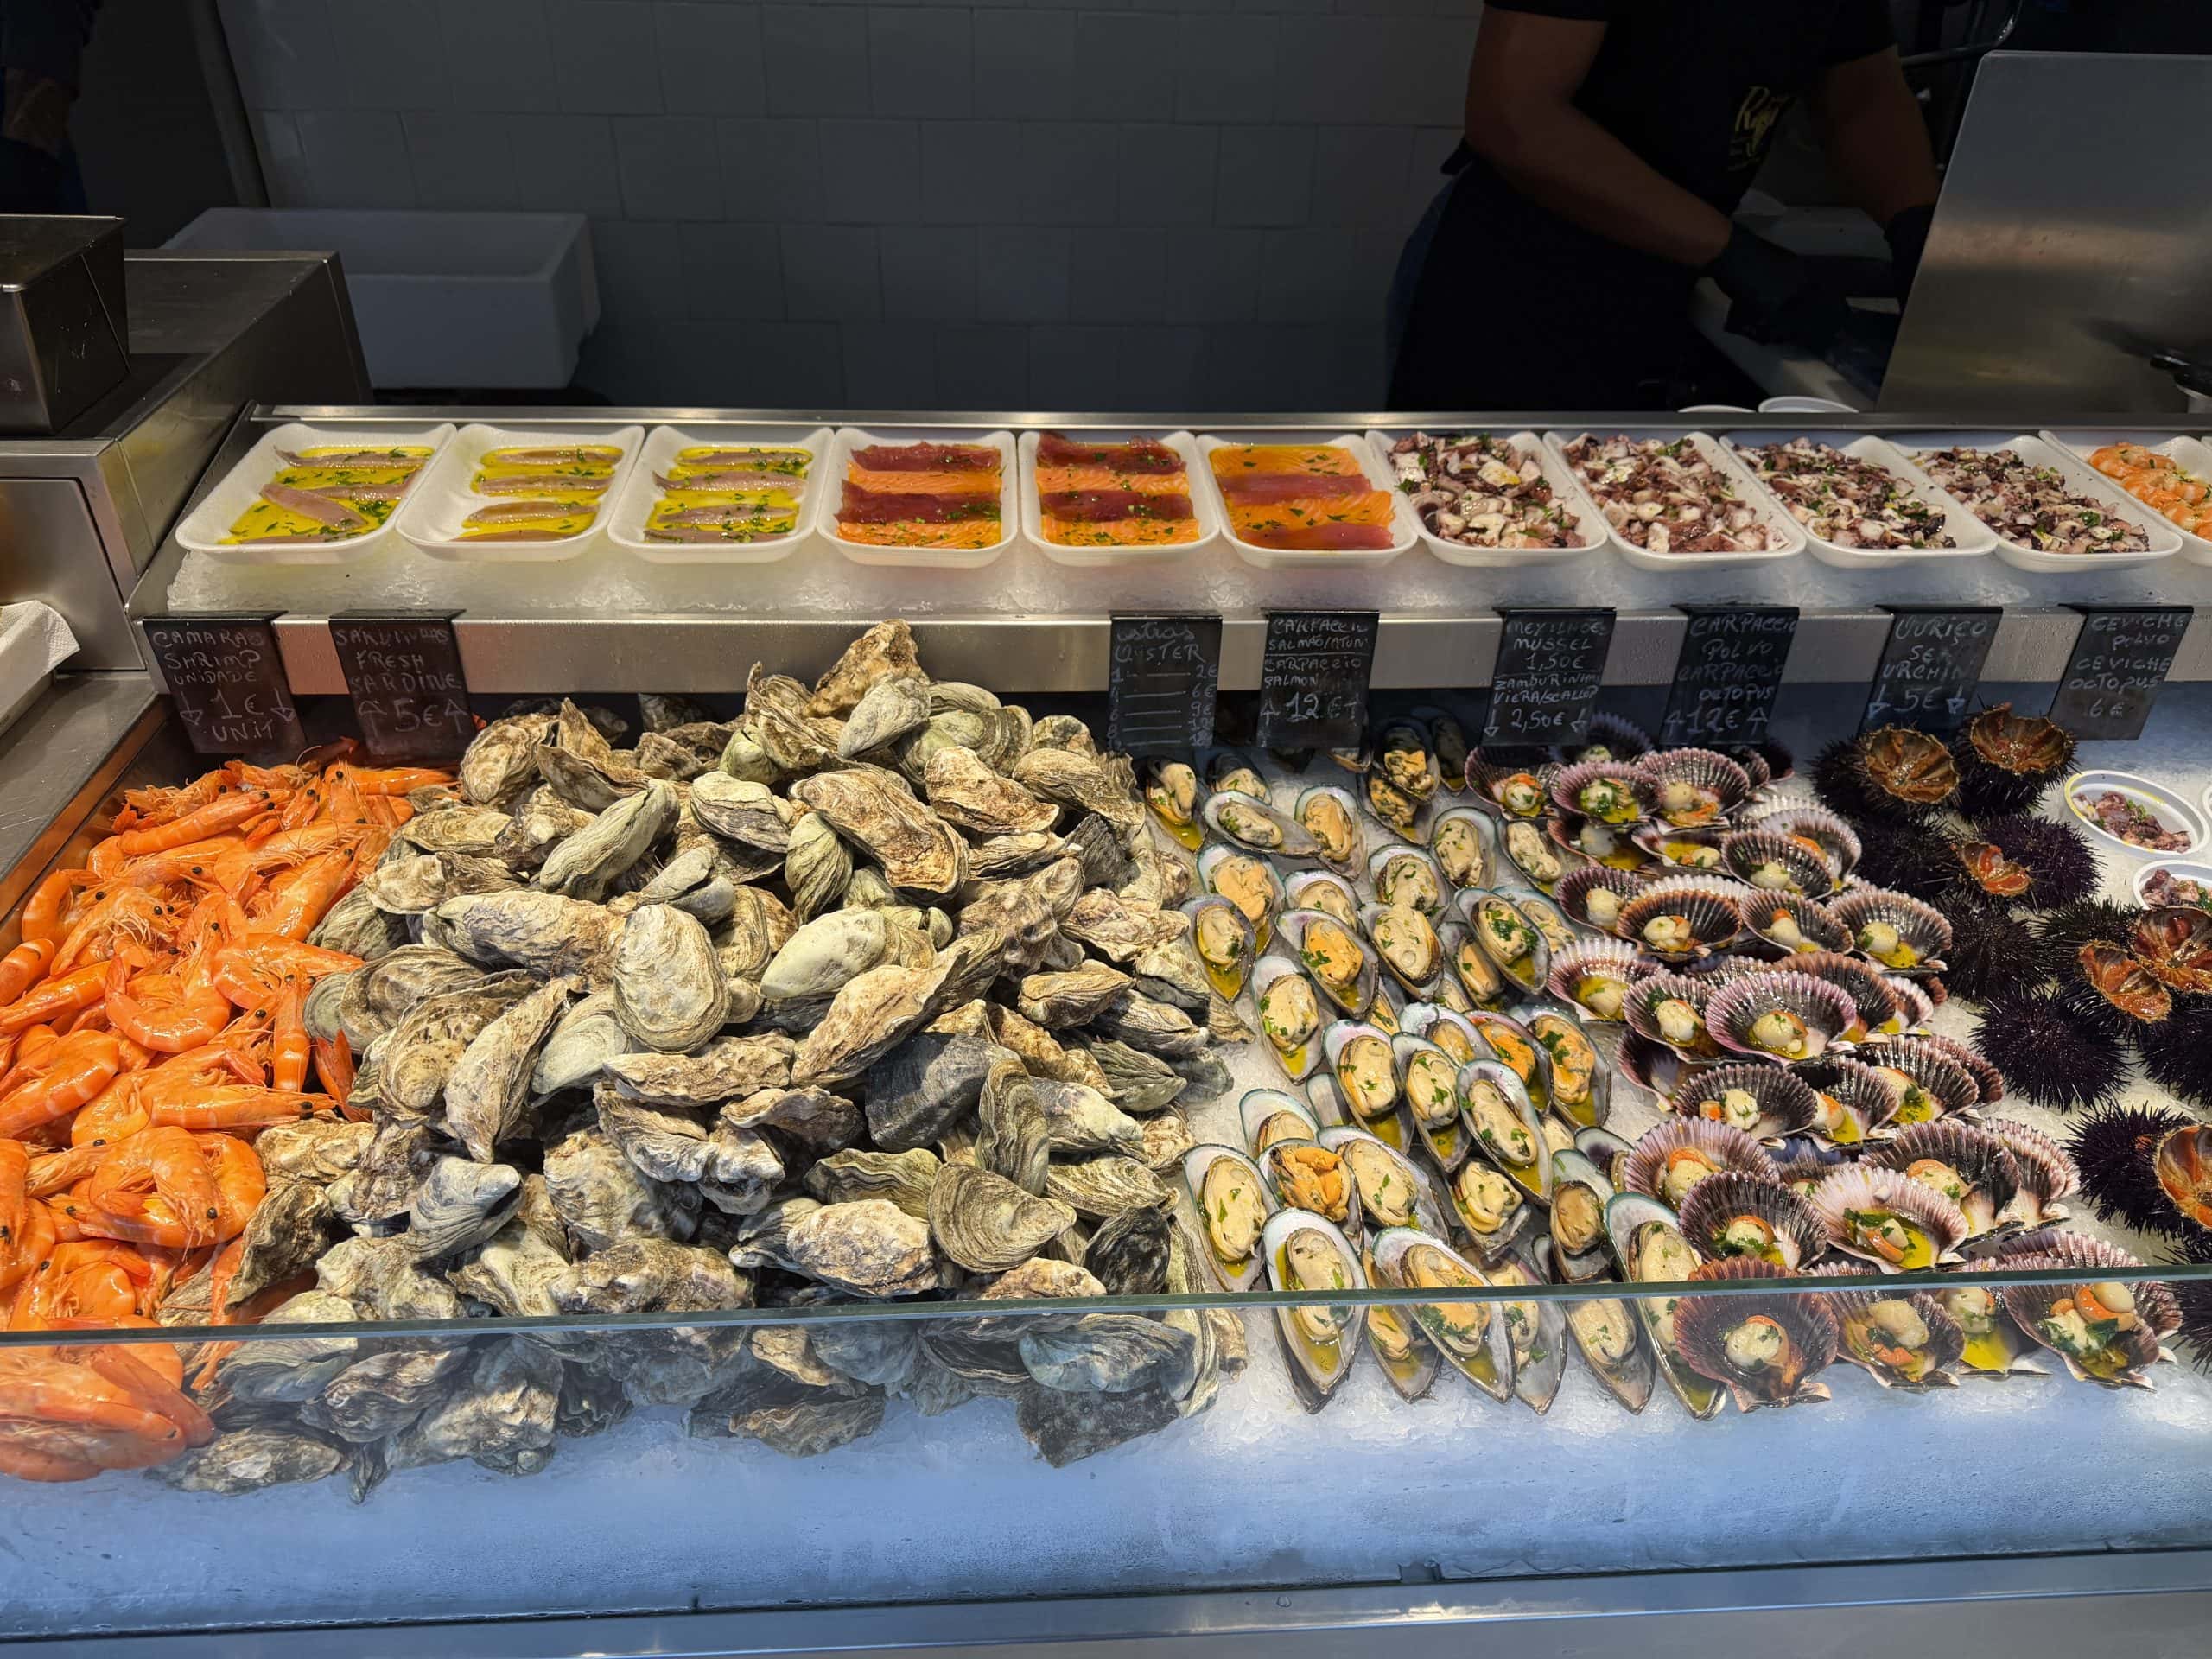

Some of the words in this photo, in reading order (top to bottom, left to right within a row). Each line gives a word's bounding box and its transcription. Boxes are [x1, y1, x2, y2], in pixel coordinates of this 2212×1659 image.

[1690, 613, 1797, 636] CARPACCIO
[2091, 614, 2186, 632] CEVICHE
[1514, 638, 1592, 651] MUSSEL
[1702, 639, 1774, 661] POLVO
[164, 650, 261, 670] SHRIMP
[356, 650, 424, 670] FRESH
[1264, 656, 1361, 672] CARPACCIO
[2075, 655, 2171, 671] CEVICHE
[174, 671, 257, 685] UNIDADE
[1883, 660, 1962, 681] URCHIN
[351, 671, 461, 693] SARDINE
[1699, 683, 1775, 701] OCTOPUS
[2069, 672, 2161, 696] OCTOPUS
[212, 720, 273, 741] UNIT
